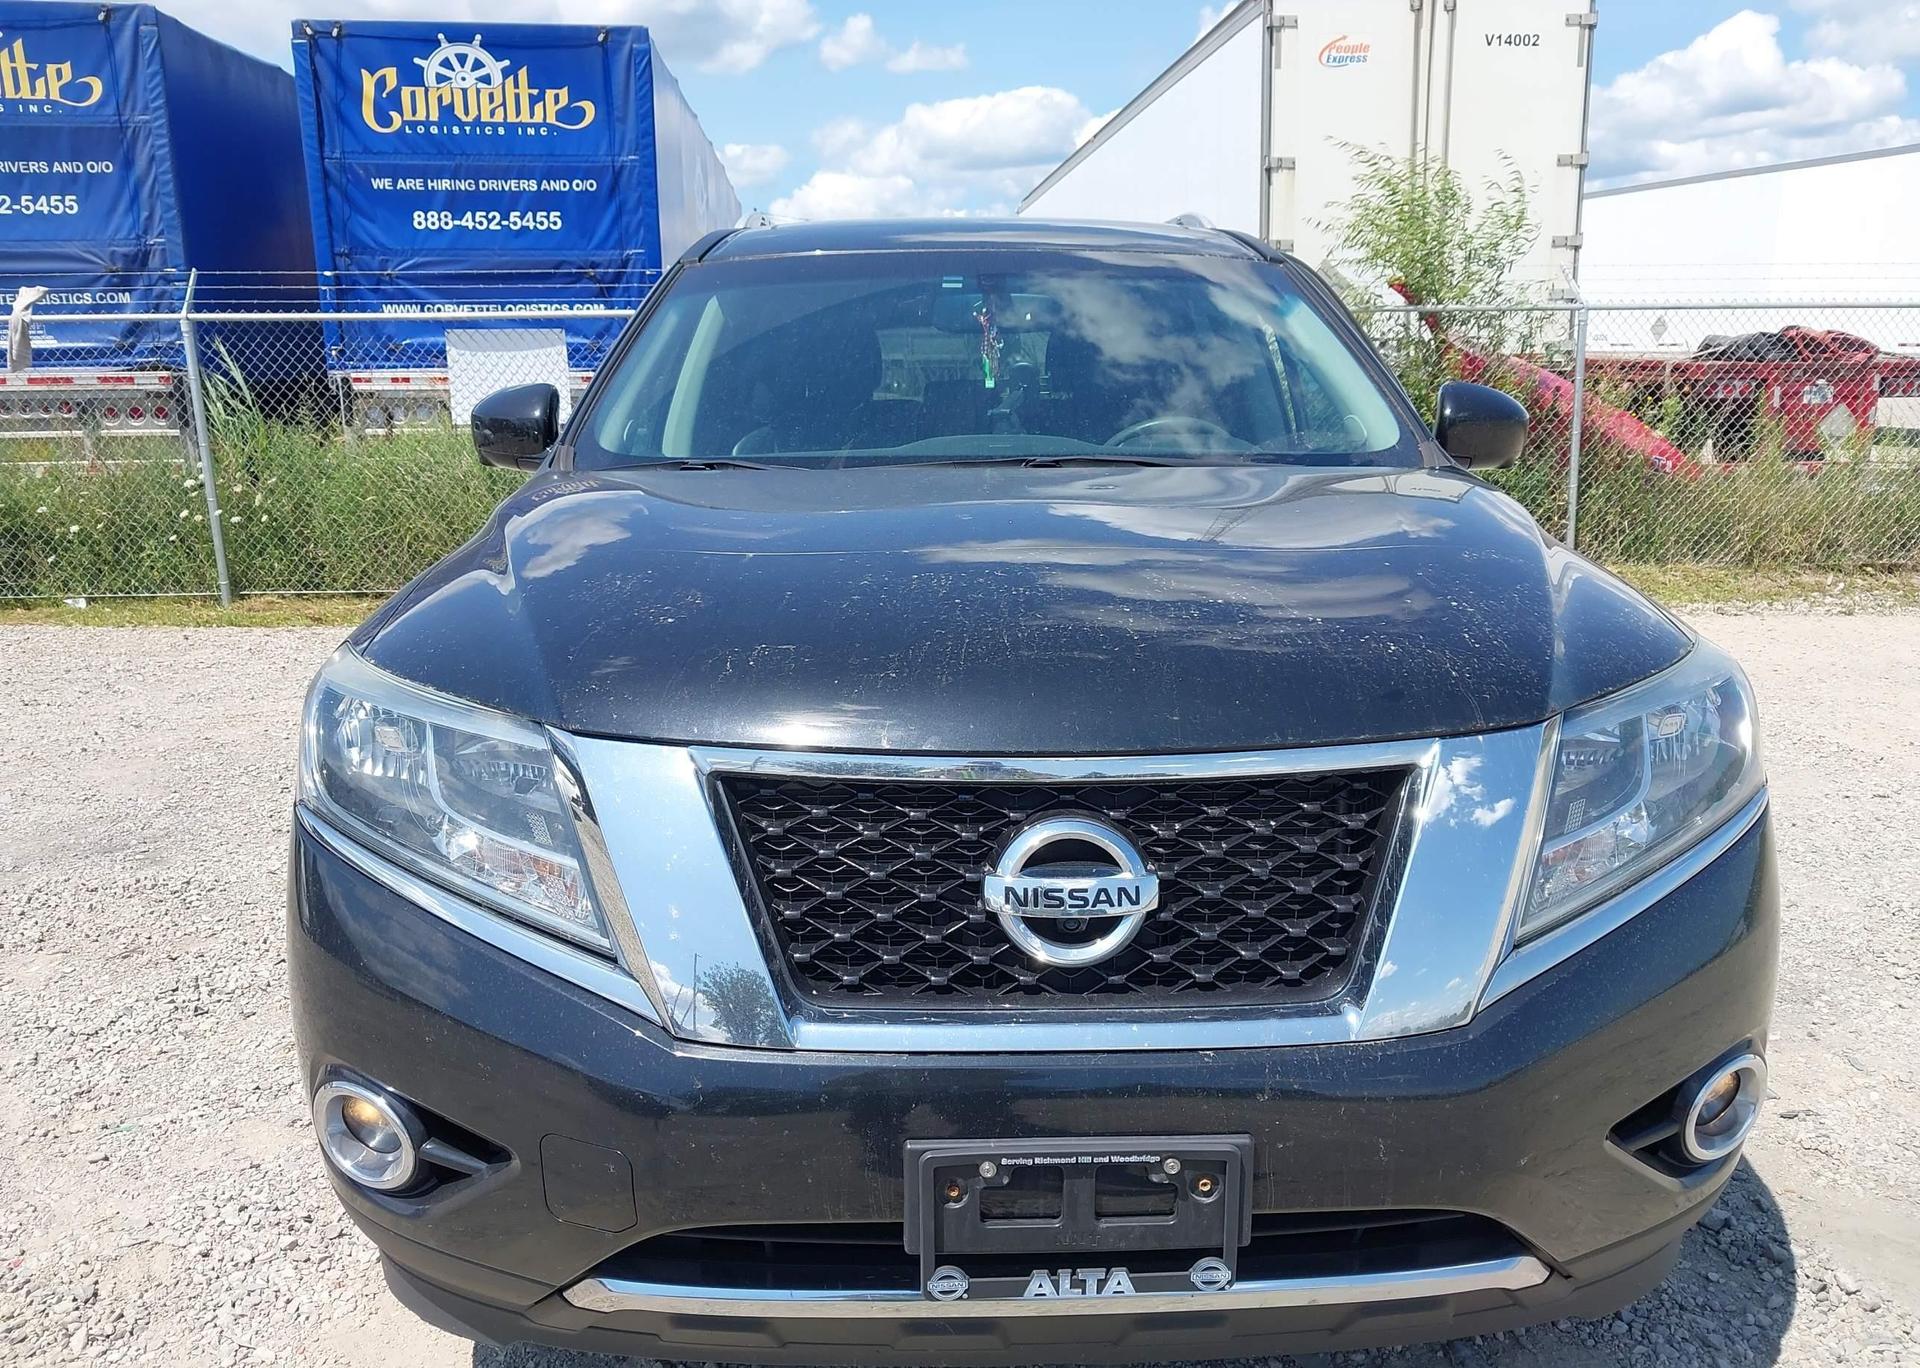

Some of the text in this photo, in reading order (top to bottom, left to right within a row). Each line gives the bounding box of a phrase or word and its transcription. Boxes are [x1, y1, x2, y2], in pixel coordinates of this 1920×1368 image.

[1485, 34, 1541, 47] V14002
[1328, 42, 1370, 55] People
[1326, 54, 1368, 65] Express
[360, 65, 596, 134] Corvette
[19, 104, 63, 113] INC.
[405, 125, 558, 136] LOGISTICS INC.
[53, 161, 84, 173] AND
[86, 161, 114, 173] O/O
[371, 177, 598, 192] WE ARE HIRING DRIVERS AND O/O
[0, 194, 79, 215] 2-5455
[412, 211, 562, 231] 888-452-5455
[1004, 885, 1141, 910] NISSAN
[1001, 1157, 1033, 1166] Serving
[1034, 1156, 1076, 1165] Richmond
[1093, 1155, 1110, 1164] and
[1111, 1154, 1161, 1164] Woodbridge
[1023, 1267, 1137, 1297] ALTA
